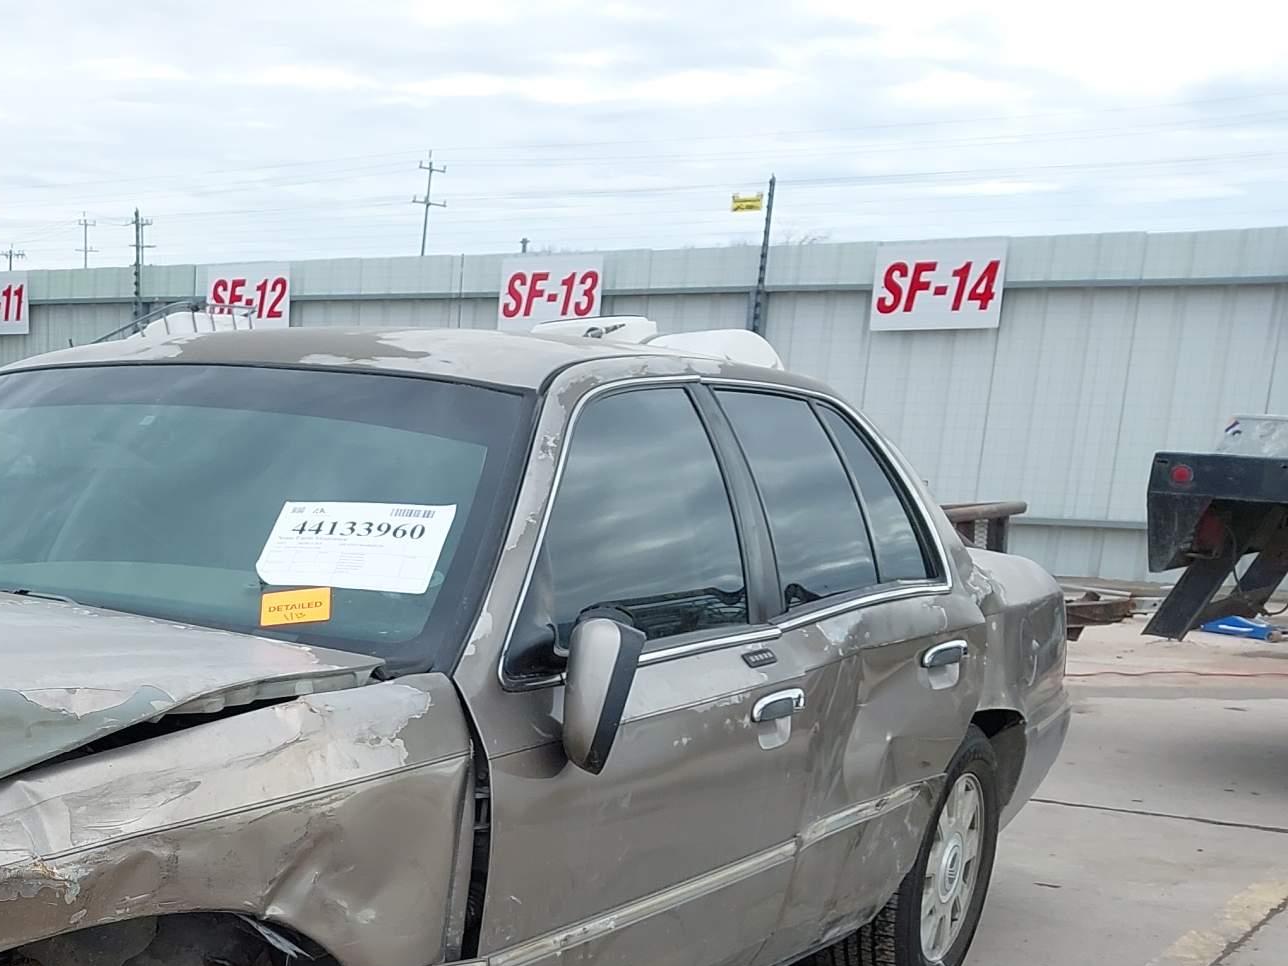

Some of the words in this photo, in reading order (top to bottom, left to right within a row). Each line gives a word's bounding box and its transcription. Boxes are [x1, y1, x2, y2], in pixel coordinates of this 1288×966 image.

[212, 277, 288, 319] SF-12
[502, 269, 600, 319] SF-13
[876, 259, 1001, 314] SF-14
[292, 520, 426, 540] 44133960
[268, 600, 323, 613] DETAILED
